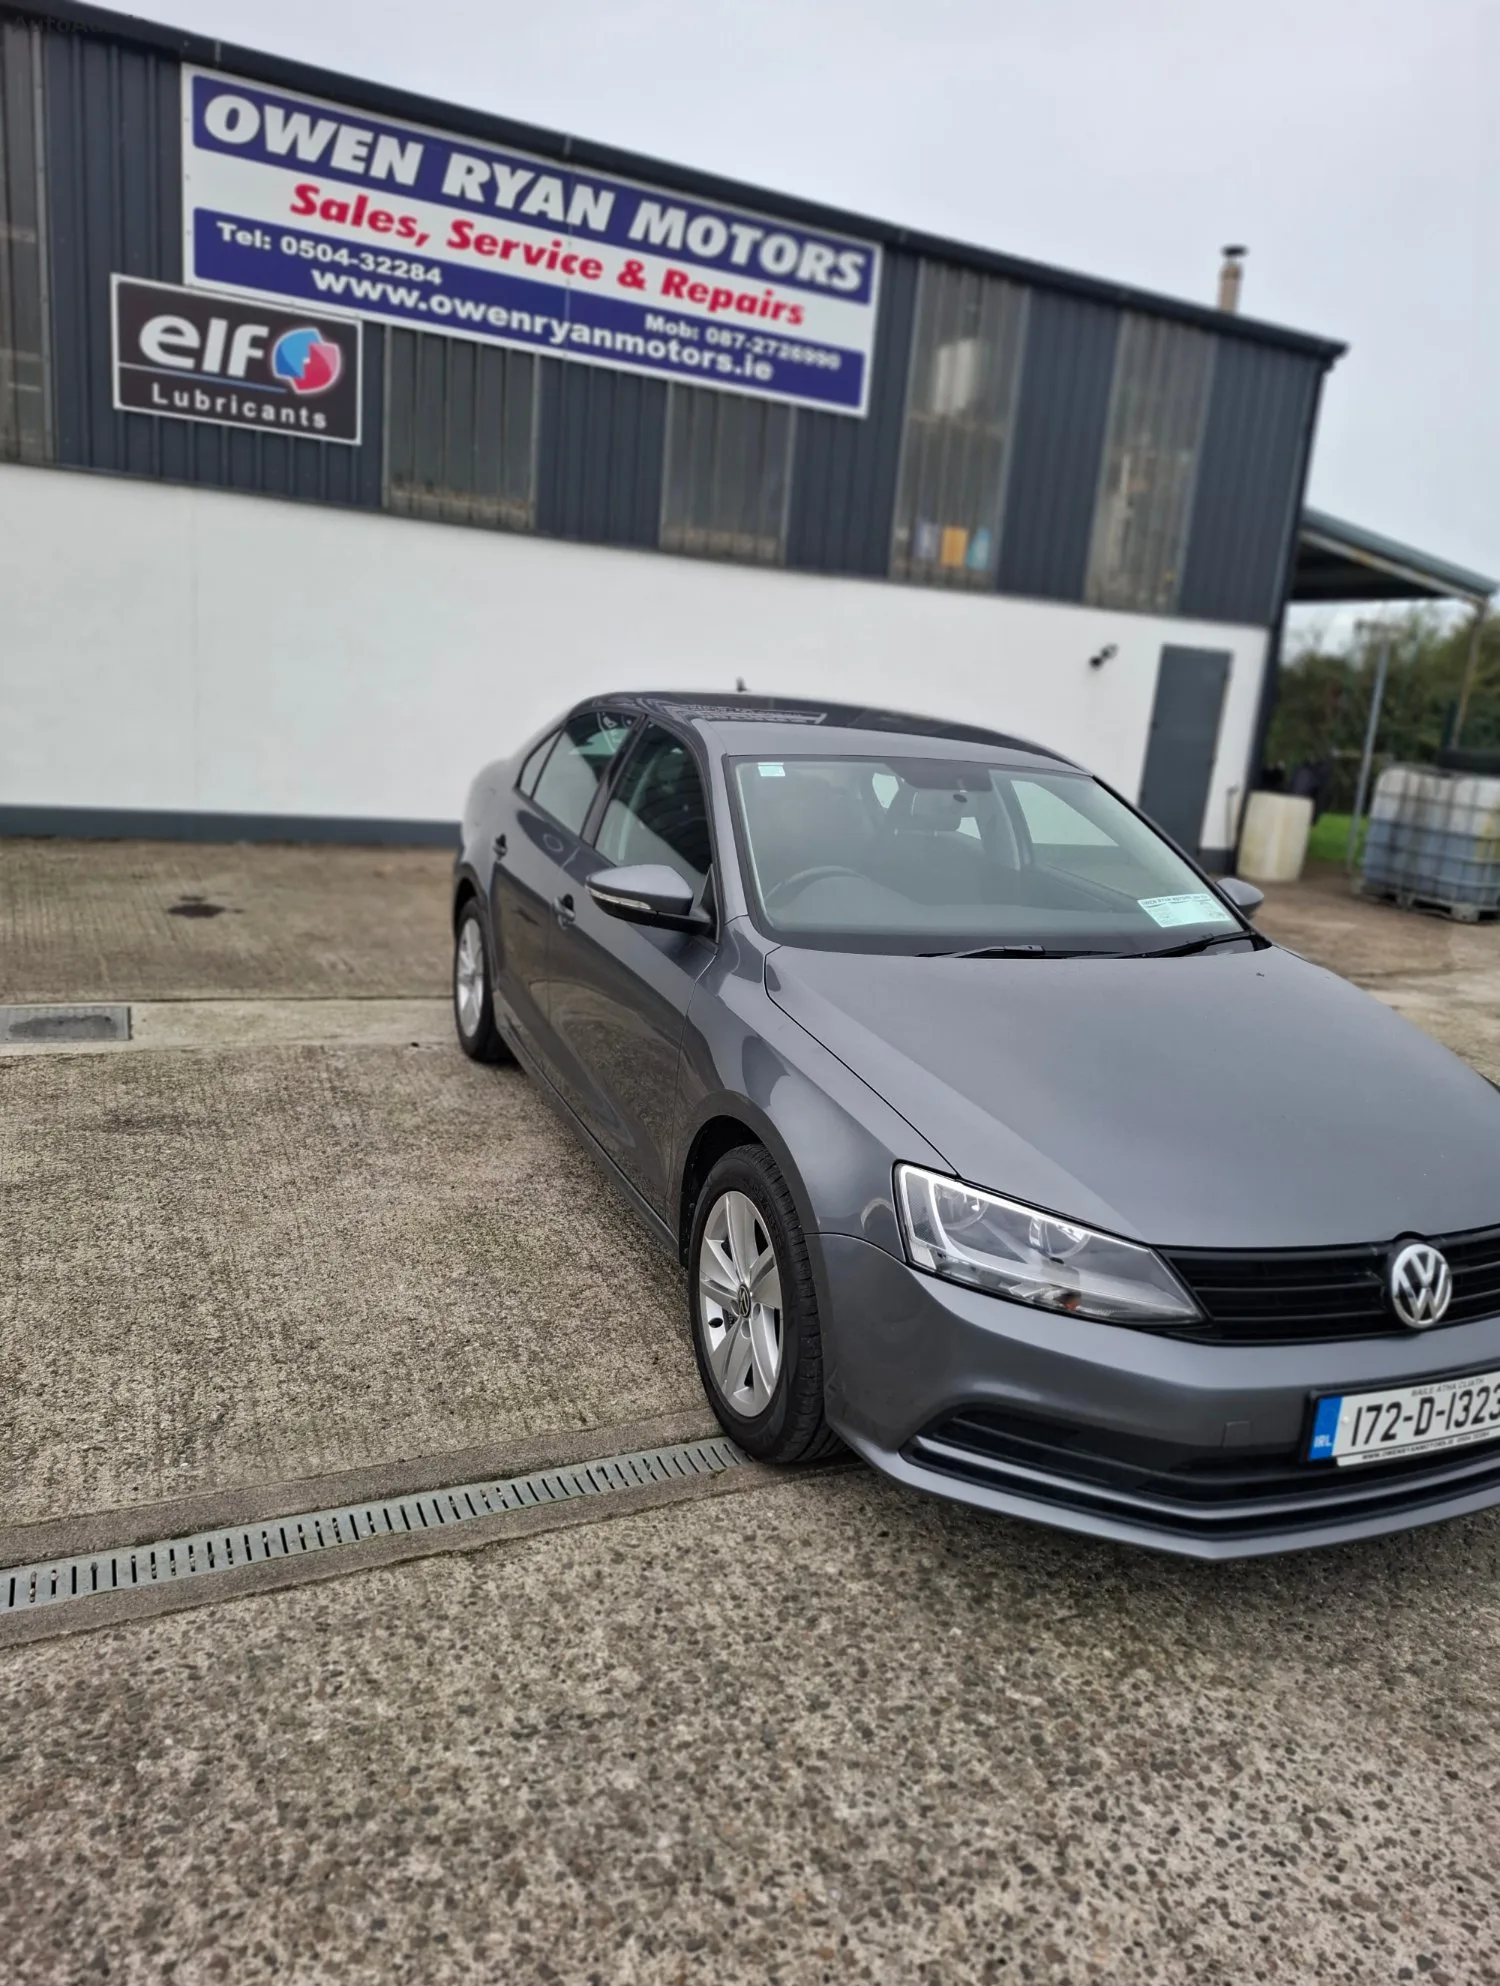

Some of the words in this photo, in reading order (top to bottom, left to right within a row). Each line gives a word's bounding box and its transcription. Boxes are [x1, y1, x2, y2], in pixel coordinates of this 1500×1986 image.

[203, 93, 424, 186] OWEN
[441, 152, 615, 232] RYAN
[627, 199, 866, 292] MOTORS
[216, 221, 272, 250] Tel:
[280, 236, 443, 286] 0504-32284
[289, 183, 430, 247] Sales,
[446, 219, 604, 280] Service
[616, 258, 647, 291] &
[660, 268, 806, 327] Repairs
[138, 314, 269, 378] elf
[311, 269, 774, 382] www.owenryanmotors.ie
[645, 313, 699, 341] Mob:
[151, 382, 328, 430] Lubricants
[1313, 1434, 1333, 1449] IRL
